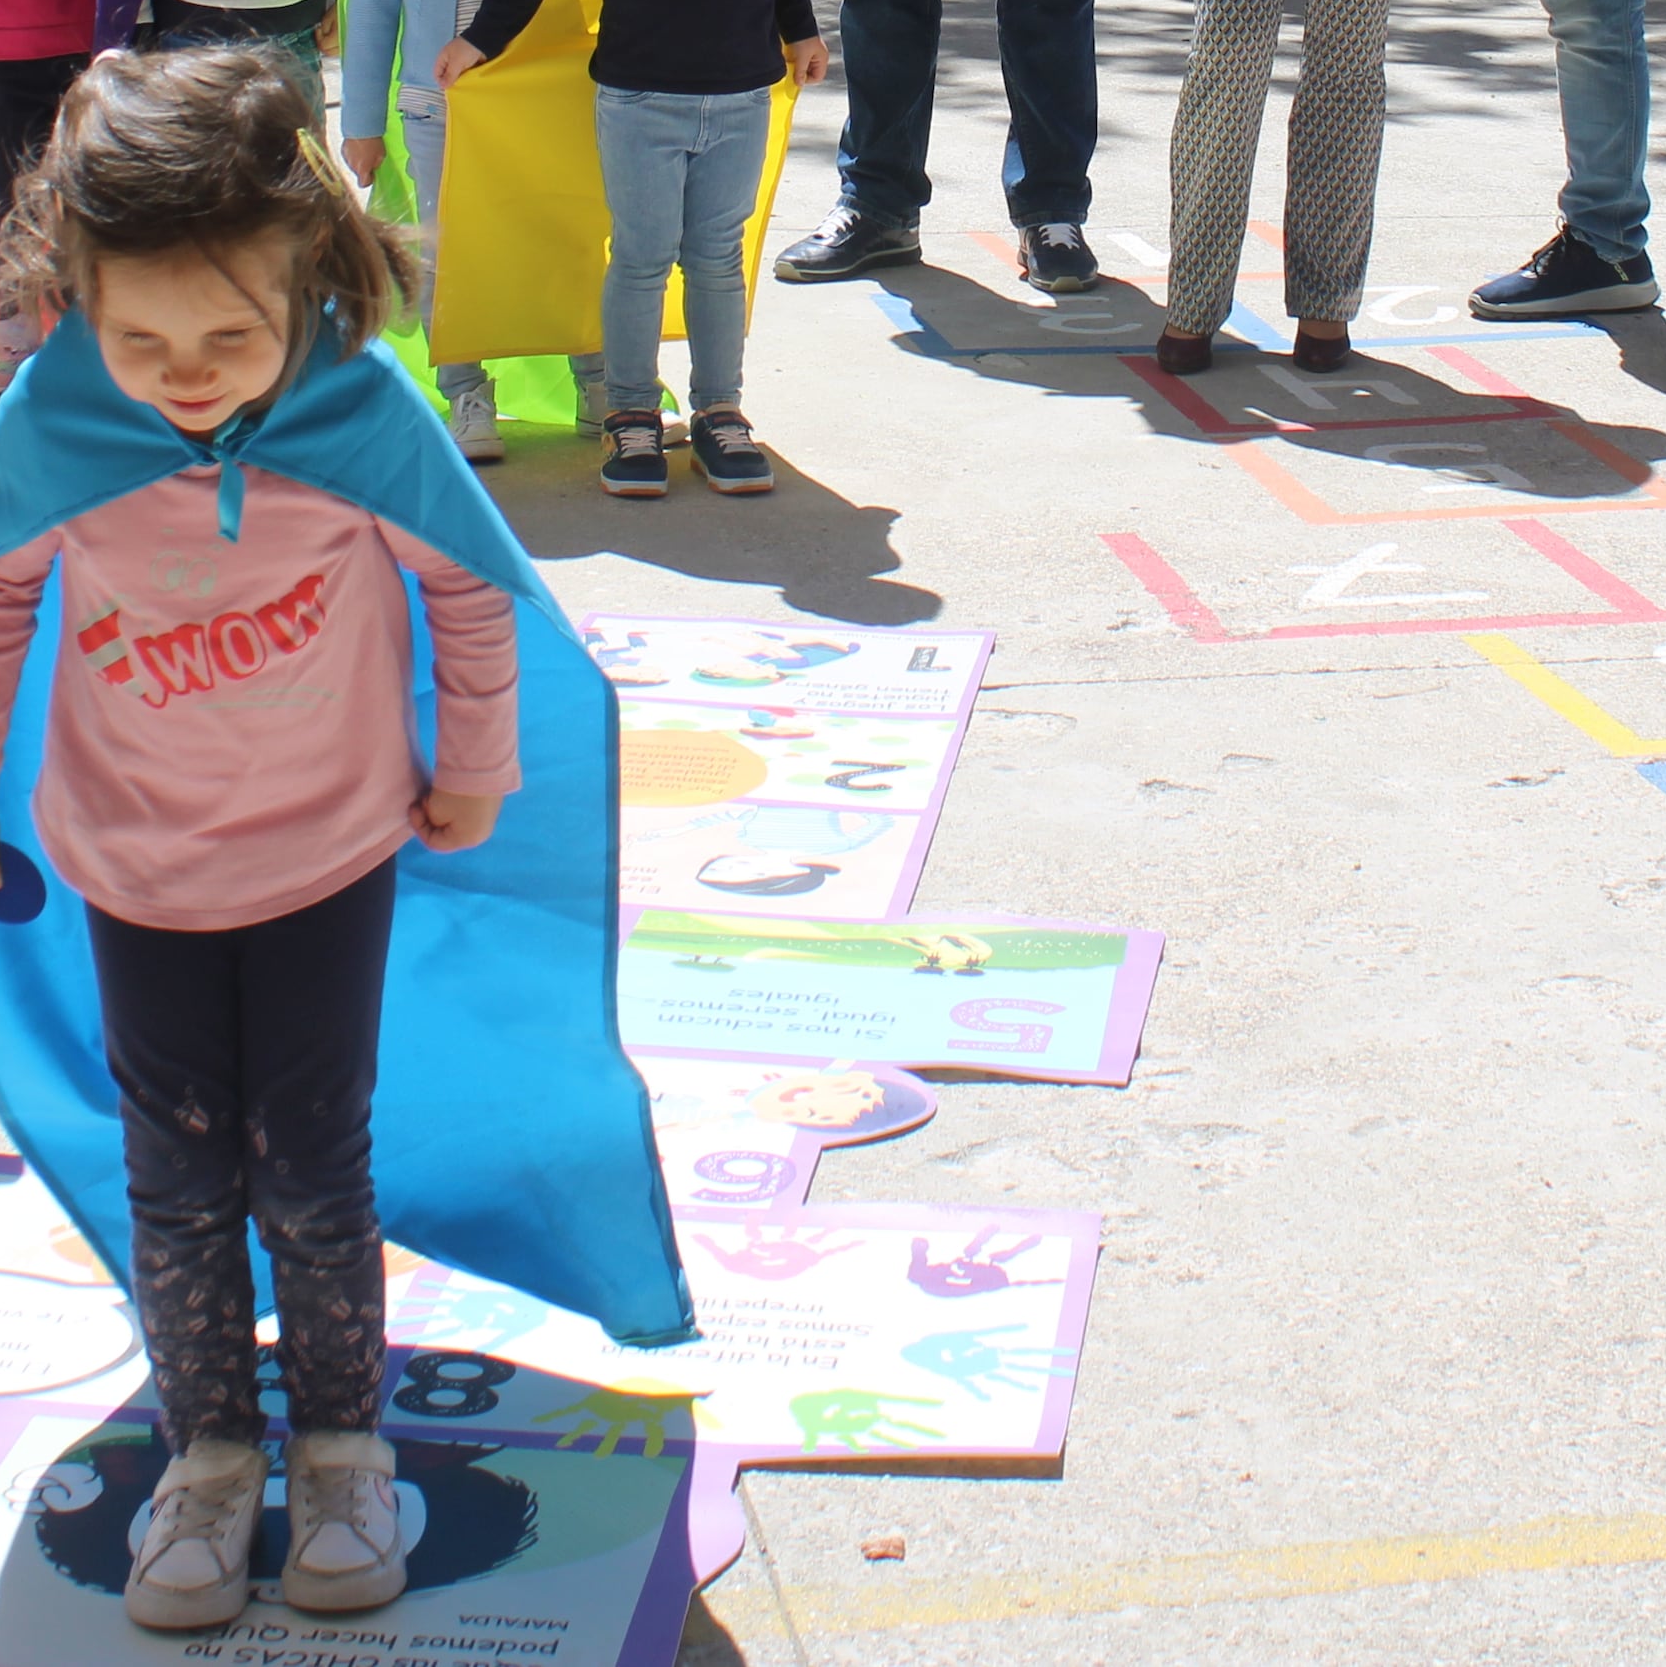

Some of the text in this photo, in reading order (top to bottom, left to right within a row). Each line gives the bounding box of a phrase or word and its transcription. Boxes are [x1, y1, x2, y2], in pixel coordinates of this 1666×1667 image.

[1256, 363, 1420, 410] 4
[1287, 541, 1491, 607] 7
[133, 574, 326, 709] WOW
[823, 760, 908, 792] 2
[660, 999, 800, 1017] seremos
[727, 987, 841, 1008] iguales
[656, 1013, 888, 1040] Si nos educan
[945, 997, 1067, 1054] 5
[692, 1297, 824, 1317] irrepetib
[694, 1313, 874, 1336] Somos espe
[704, 1330, 735, 1346] ig
[746, 1334, 771, 1350] la
[766, 1352, 792, 1367] la
[801, 1353, 840, 1371] En
[393, 1353, 517, 1419] 8
[457, 1613, 572, 1632] MAFALDA
[184, 1643, 222, 1659] no
[301, 1630, 398, 1651] hacer
[410, 1635, 562, 1657] podemos
